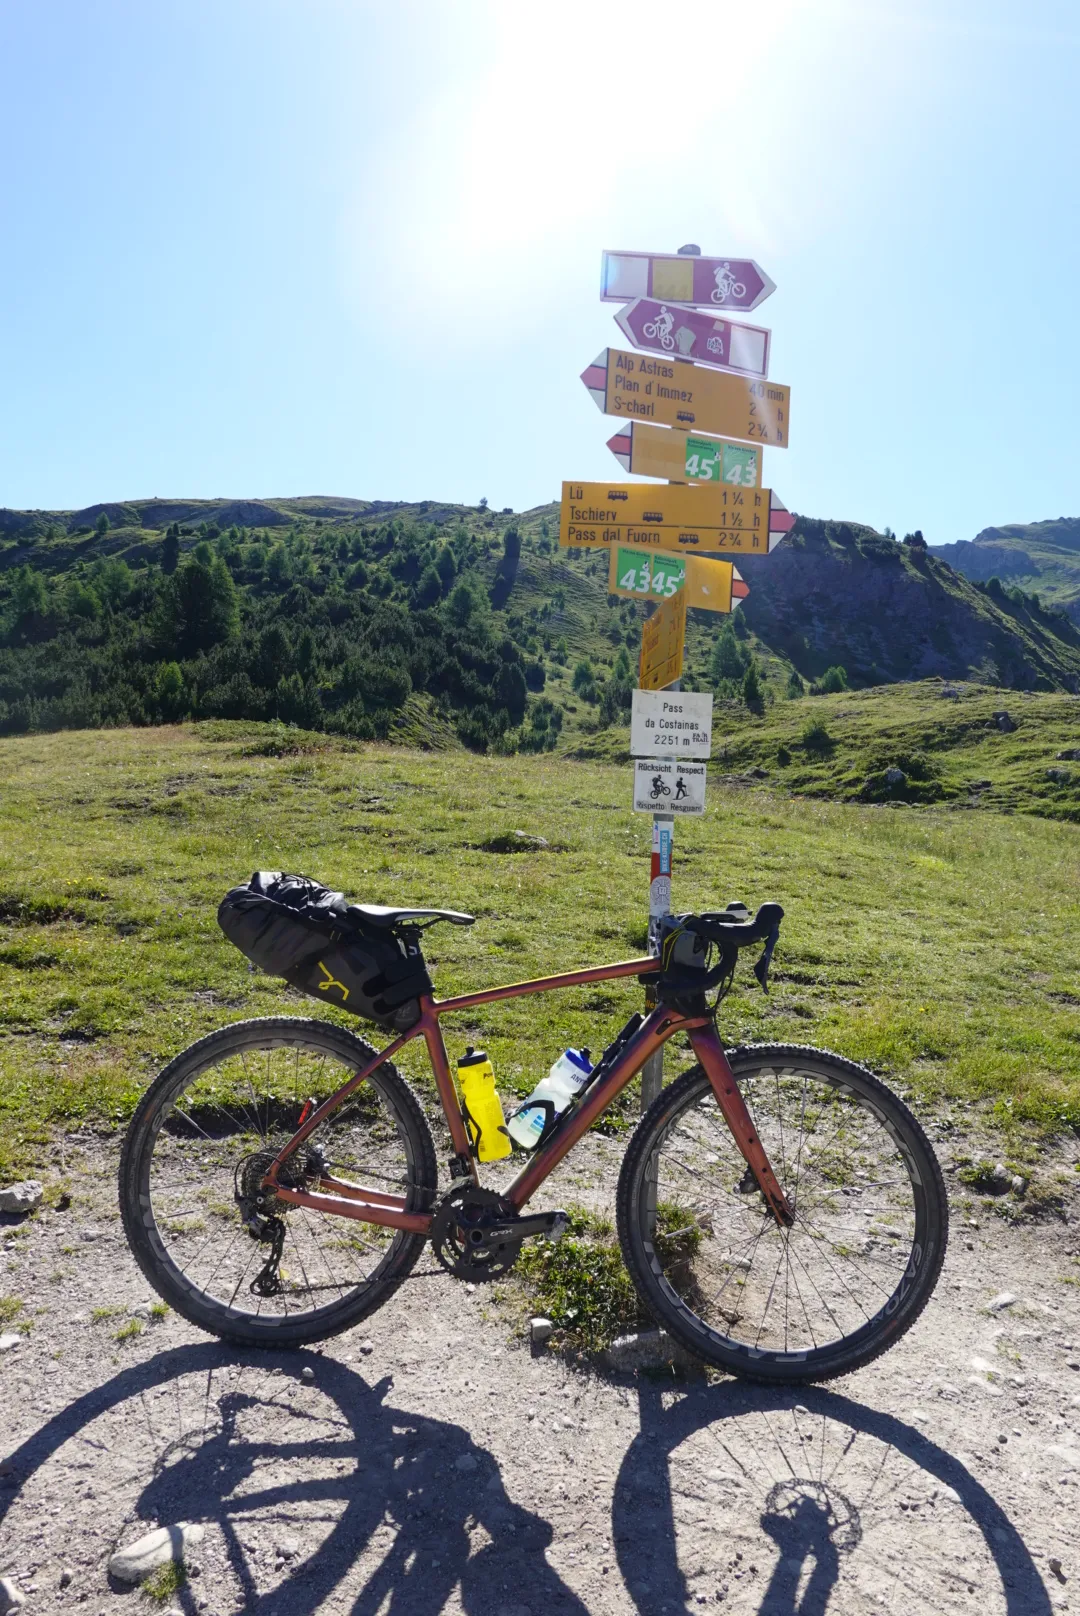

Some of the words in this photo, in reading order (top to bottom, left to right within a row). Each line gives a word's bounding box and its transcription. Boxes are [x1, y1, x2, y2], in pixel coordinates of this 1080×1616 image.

[616, 355, 634, 373] Alp
[639, 359, 674, 378] Astras
[767, 388, 784, 402] min
[615, 374, 640, 393] Plan
[749, 402, 757, 416] 2
[777, 407, 784, 421] h
[614, 395, 655, 416] S-charl
[776, 427, 783, 441] h
[685, 454, 715, 480] 45
[726, 463, 757, 488] 43
[569, 486, 583, 500] Lü
[754, 492, 761, 507] h
[569, 505, 617, 522] Tschierv
[753, 513, 760, 527] h
[568, 528, 596, 542] Pass
[602, 528, 620, 542] dal
[627, 529, 660, 543] Fuorn
[752, 534, 759, 547] h
[620, 568, 651, 593] 43
[651, 571, 680, 598] 45
[663, 702, 683, 713] Pass
[645, 718, 655, 728] da
[659, 719, 699, 730] Costainas
[654, 735, 679, 746] 2251
[682, 738, 690, 746] m
[638, 762, 672, 773] Rücksicht
[676, 765, 704, 775] Respect
